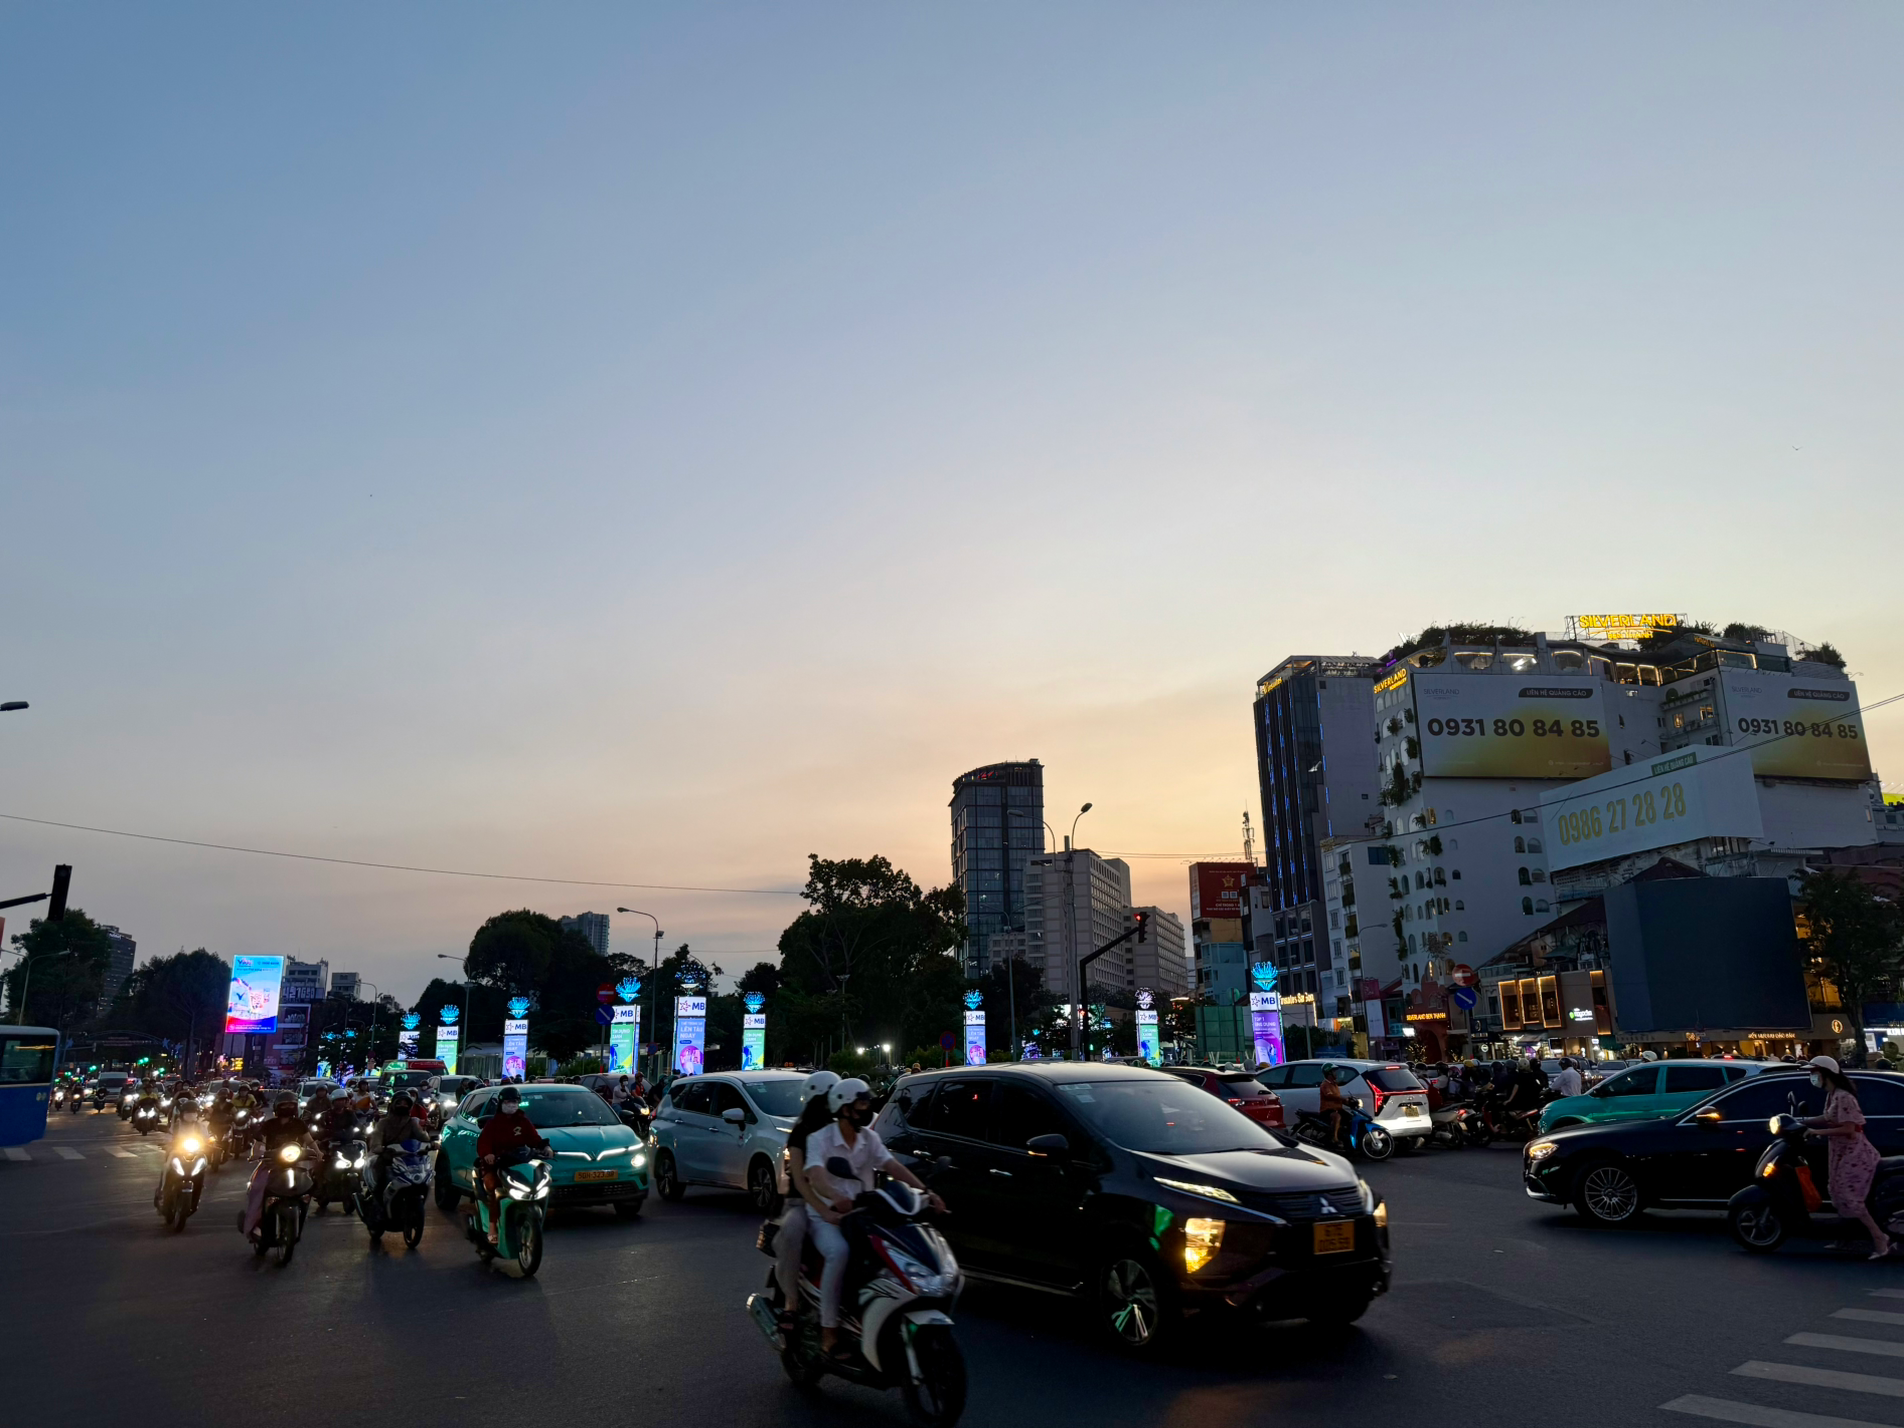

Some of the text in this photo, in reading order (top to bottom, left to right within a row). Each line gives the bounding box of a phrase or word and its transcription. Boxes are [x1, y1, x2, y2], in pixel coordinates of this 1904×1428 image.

[1580, 614, 1677, 628] SILVERLAND
[1374, 668, 1406, 694] SILVERLAND
[1731, 686, 1762, 694] SILVERLAND
[1427, 718, 1600, 738] 0931 80 84 85
[1737, 717, 1858, 739] 0931 80 84 85
[1558, 782, 1687, 846] 0986 27 28 28
[691, 1002, 705, 1011] MB
[1261, 997, 1276, 1005] MB
[620, 1009, 634, 1018] MB
[753, 1017, 765, 1025] MB
